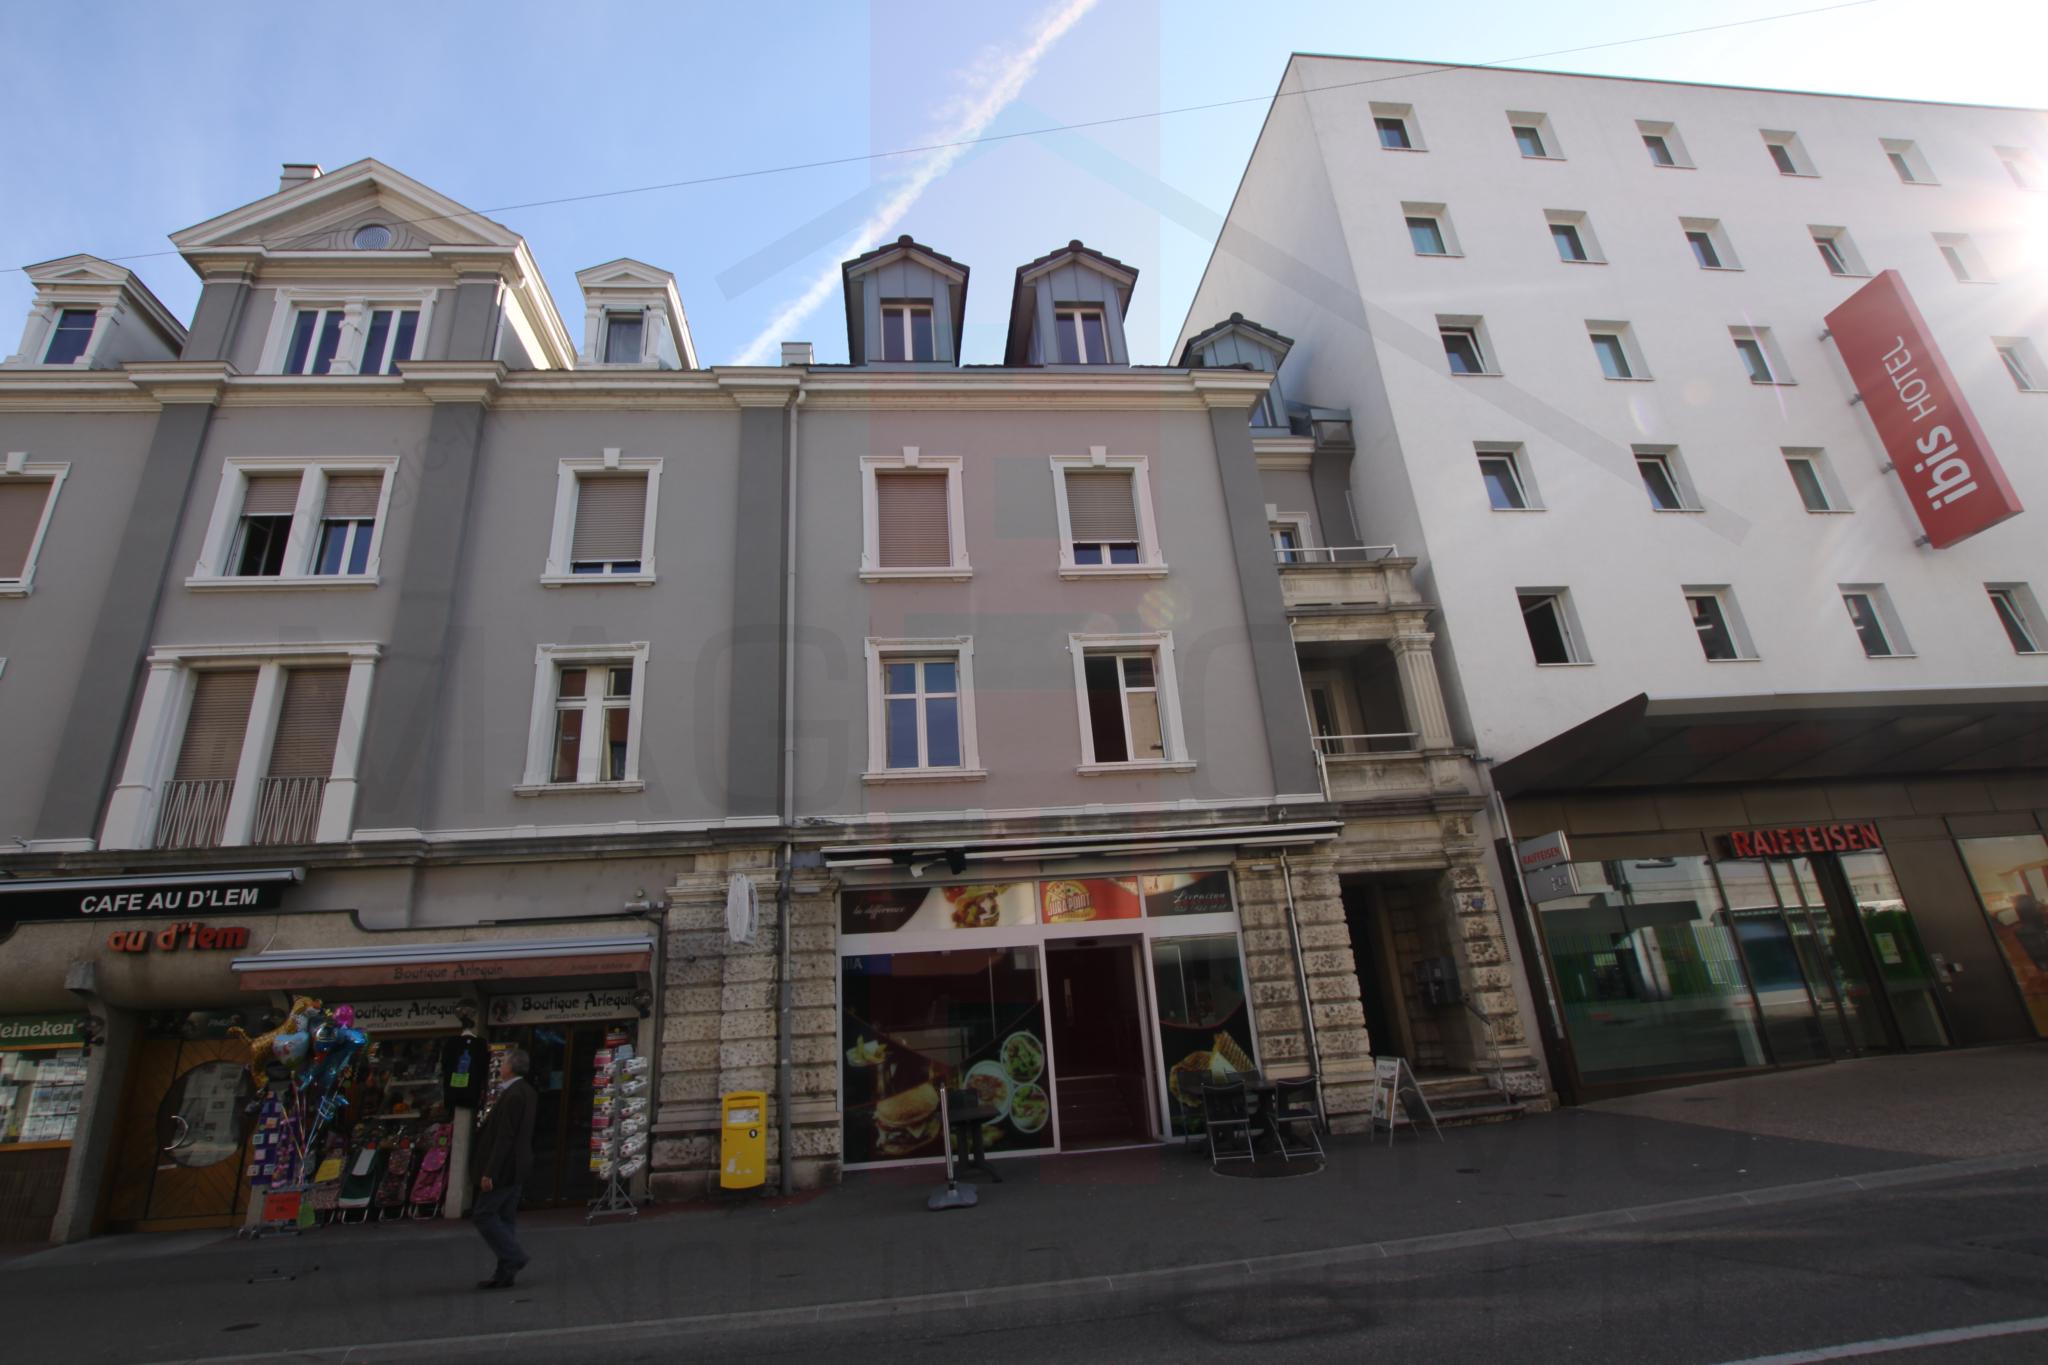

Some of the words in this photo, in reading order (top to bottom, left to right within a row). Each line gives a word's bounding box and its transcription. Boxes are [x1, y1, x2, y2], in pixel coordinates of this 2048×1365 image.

[1881, 336, 1937, 423] HOTEL
[1914, 425, 1979, 510] ibis
[1730, 823, 1881, 857] RAIFFEISEN
[80, 893, 144, 914] CAFE
[147, 891, 182, 910] AU
[188, 888, 259, 908] D'LEM
[1047, 898, 1068, 916] JURA
[1068, 893, 1091, 911] POINT
[107, 930, 151, 953] au
[156, 922, 250, 952] d'lem
[393, 965, 448, 981] Boutique
[453, 963, 504, 978] Arlequin
[355, 1003, 402, 1021] outique
[407, 1001, 457, 1018] Arlequi
[521, 996, 580, 1016] Boutique
[584, 992, 633, 1011] Arlequi
[0, 1021, 74, 1038] eineken
